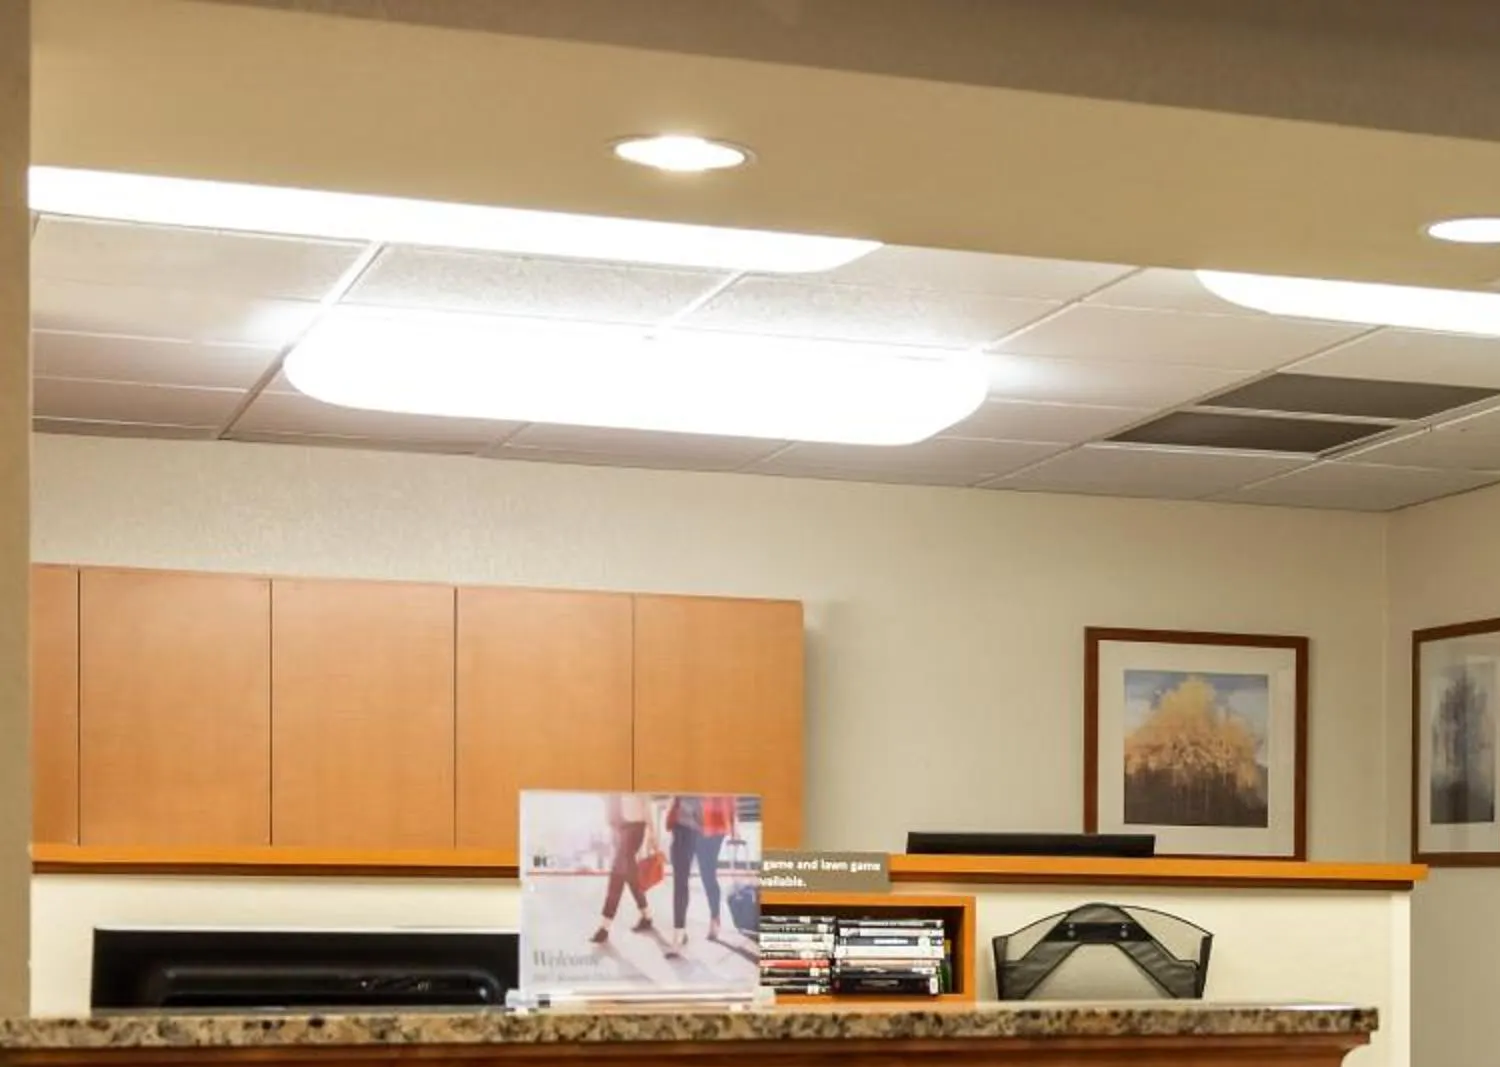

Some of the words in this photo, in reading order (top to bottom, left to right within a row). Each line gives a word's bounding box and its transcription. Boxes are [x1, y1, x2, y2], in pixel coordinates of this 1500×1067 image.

[763, 860, 794, 871] game
[796, 859, 819, 871] and
[759, 875, 808, 888] vailable.
